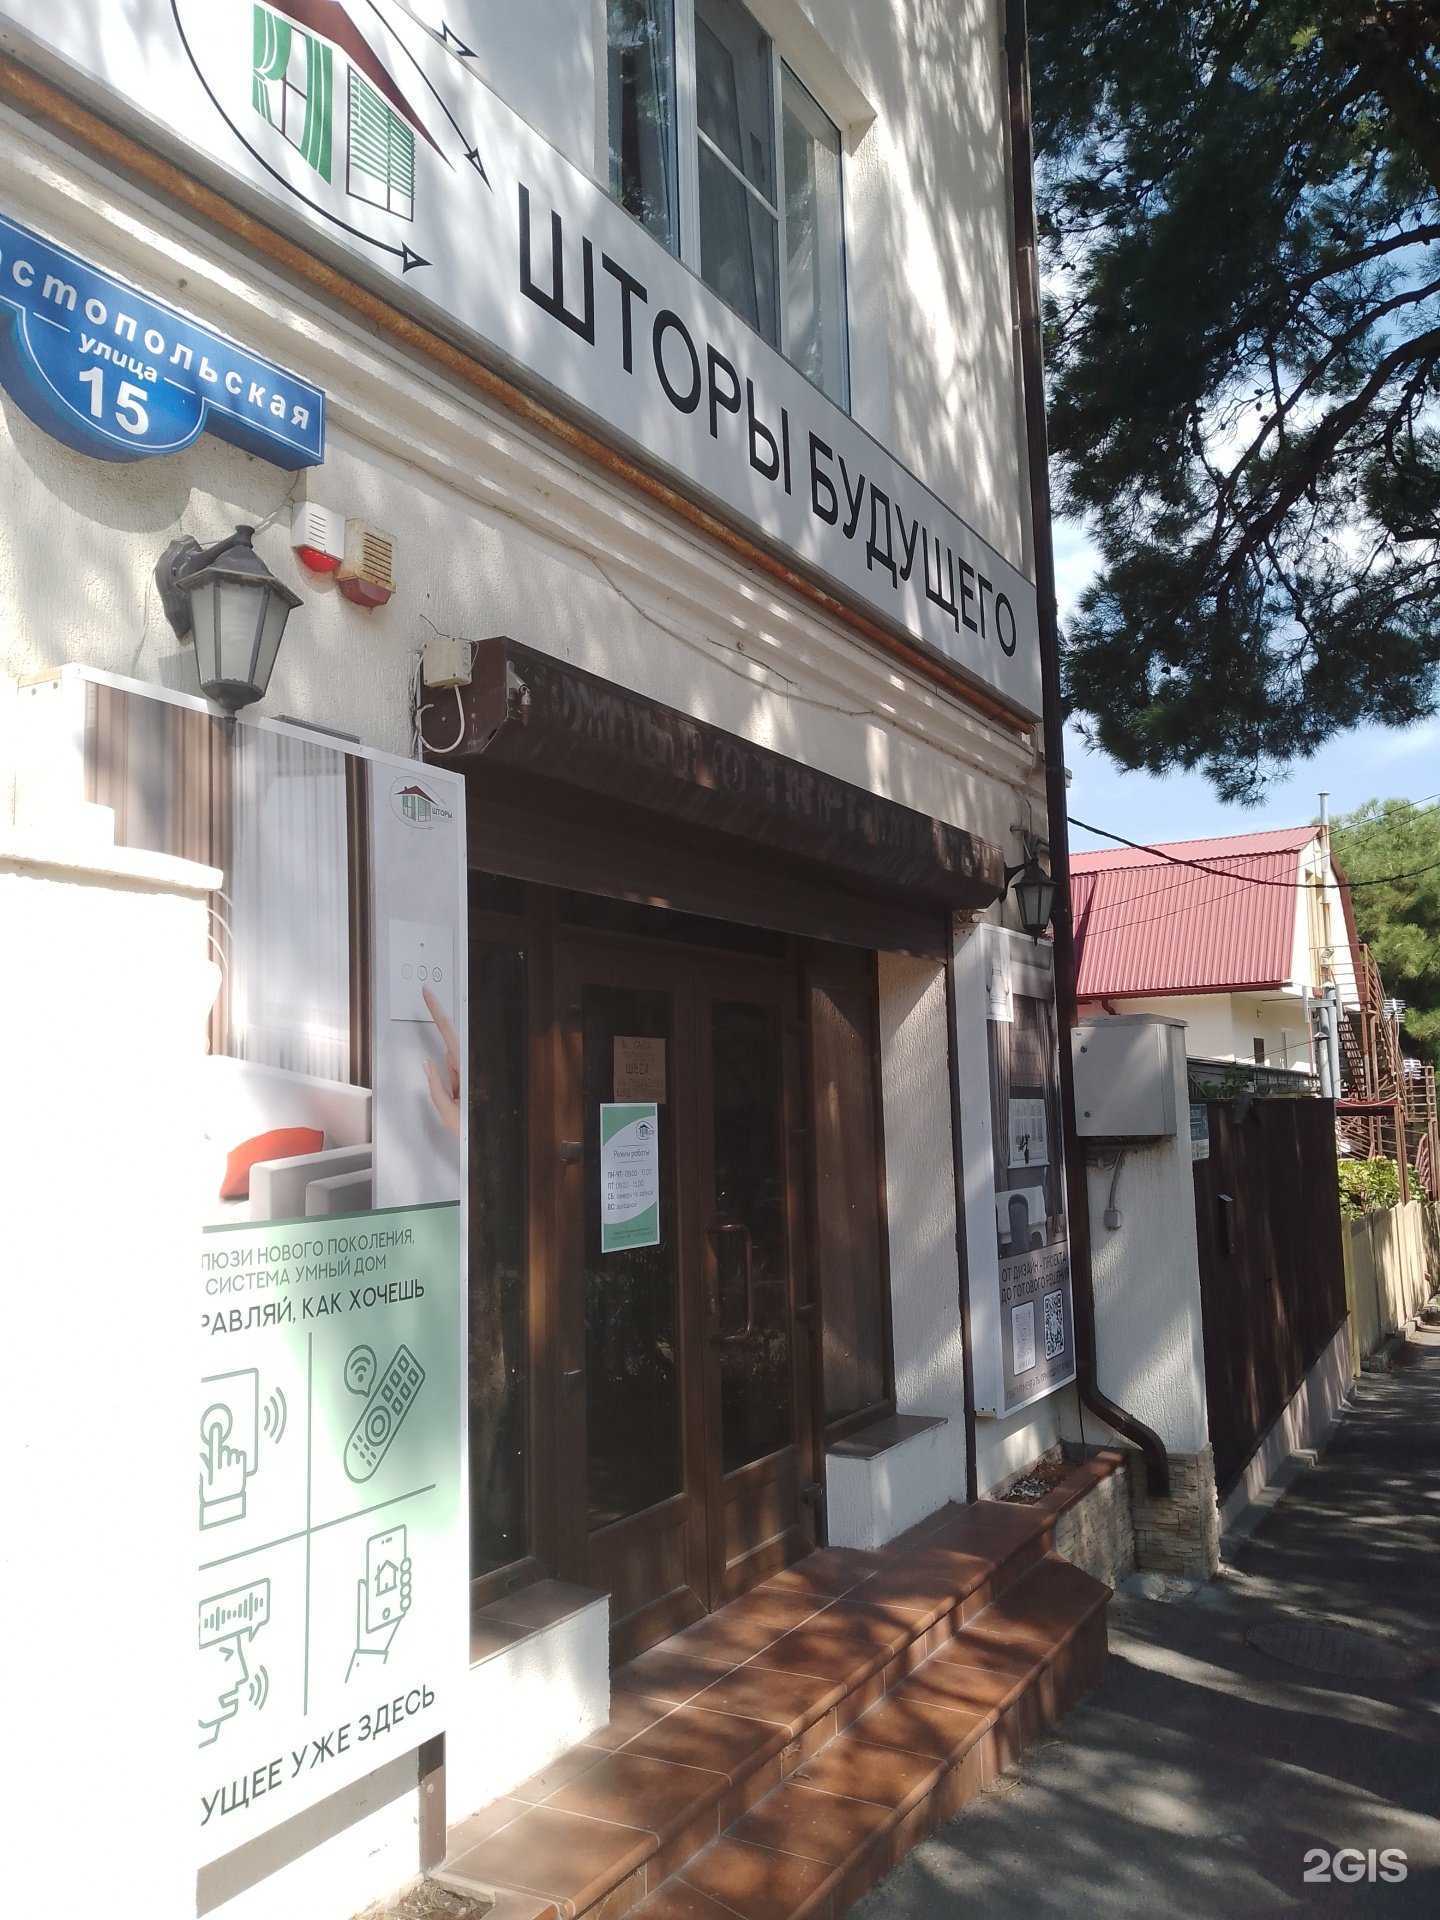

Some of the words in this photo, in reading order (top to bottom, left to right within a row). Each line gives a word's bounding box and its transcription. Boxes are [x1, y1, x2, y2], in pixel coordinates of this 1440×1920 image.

[0, 248, 310, 431] стопольская
[79, 333, 158, 383] улица
[78, 367, 150, 436] 15
[518, 182, 792, 495] ШТОРЫ
[808, 430, 1017, 657] БУДУЩЕГО
[257, 1239, 323, 1265] НОВОГО
[327, 1228, 415, 1254] ПОКОЛЕНИЯ,
[205, 1269, 290, 1296] СИСТЕМА
[295, 1256, 351, 1284] УМНЫЙ
[353, 1254, 387, 1278] ДОМ
[302, 1292, 342, 1320] КАК
[348, 1279, 425, 1311] ХОЧЕШЬ
[1001, 1267, 1011, 1282] ОТ
[200, 1757, 284, 1826] УЩЕЕ
[291, 1723, 351, 1778] УЖЕ
[357, 1684, 435, 1741] ЗДЕСЬ
